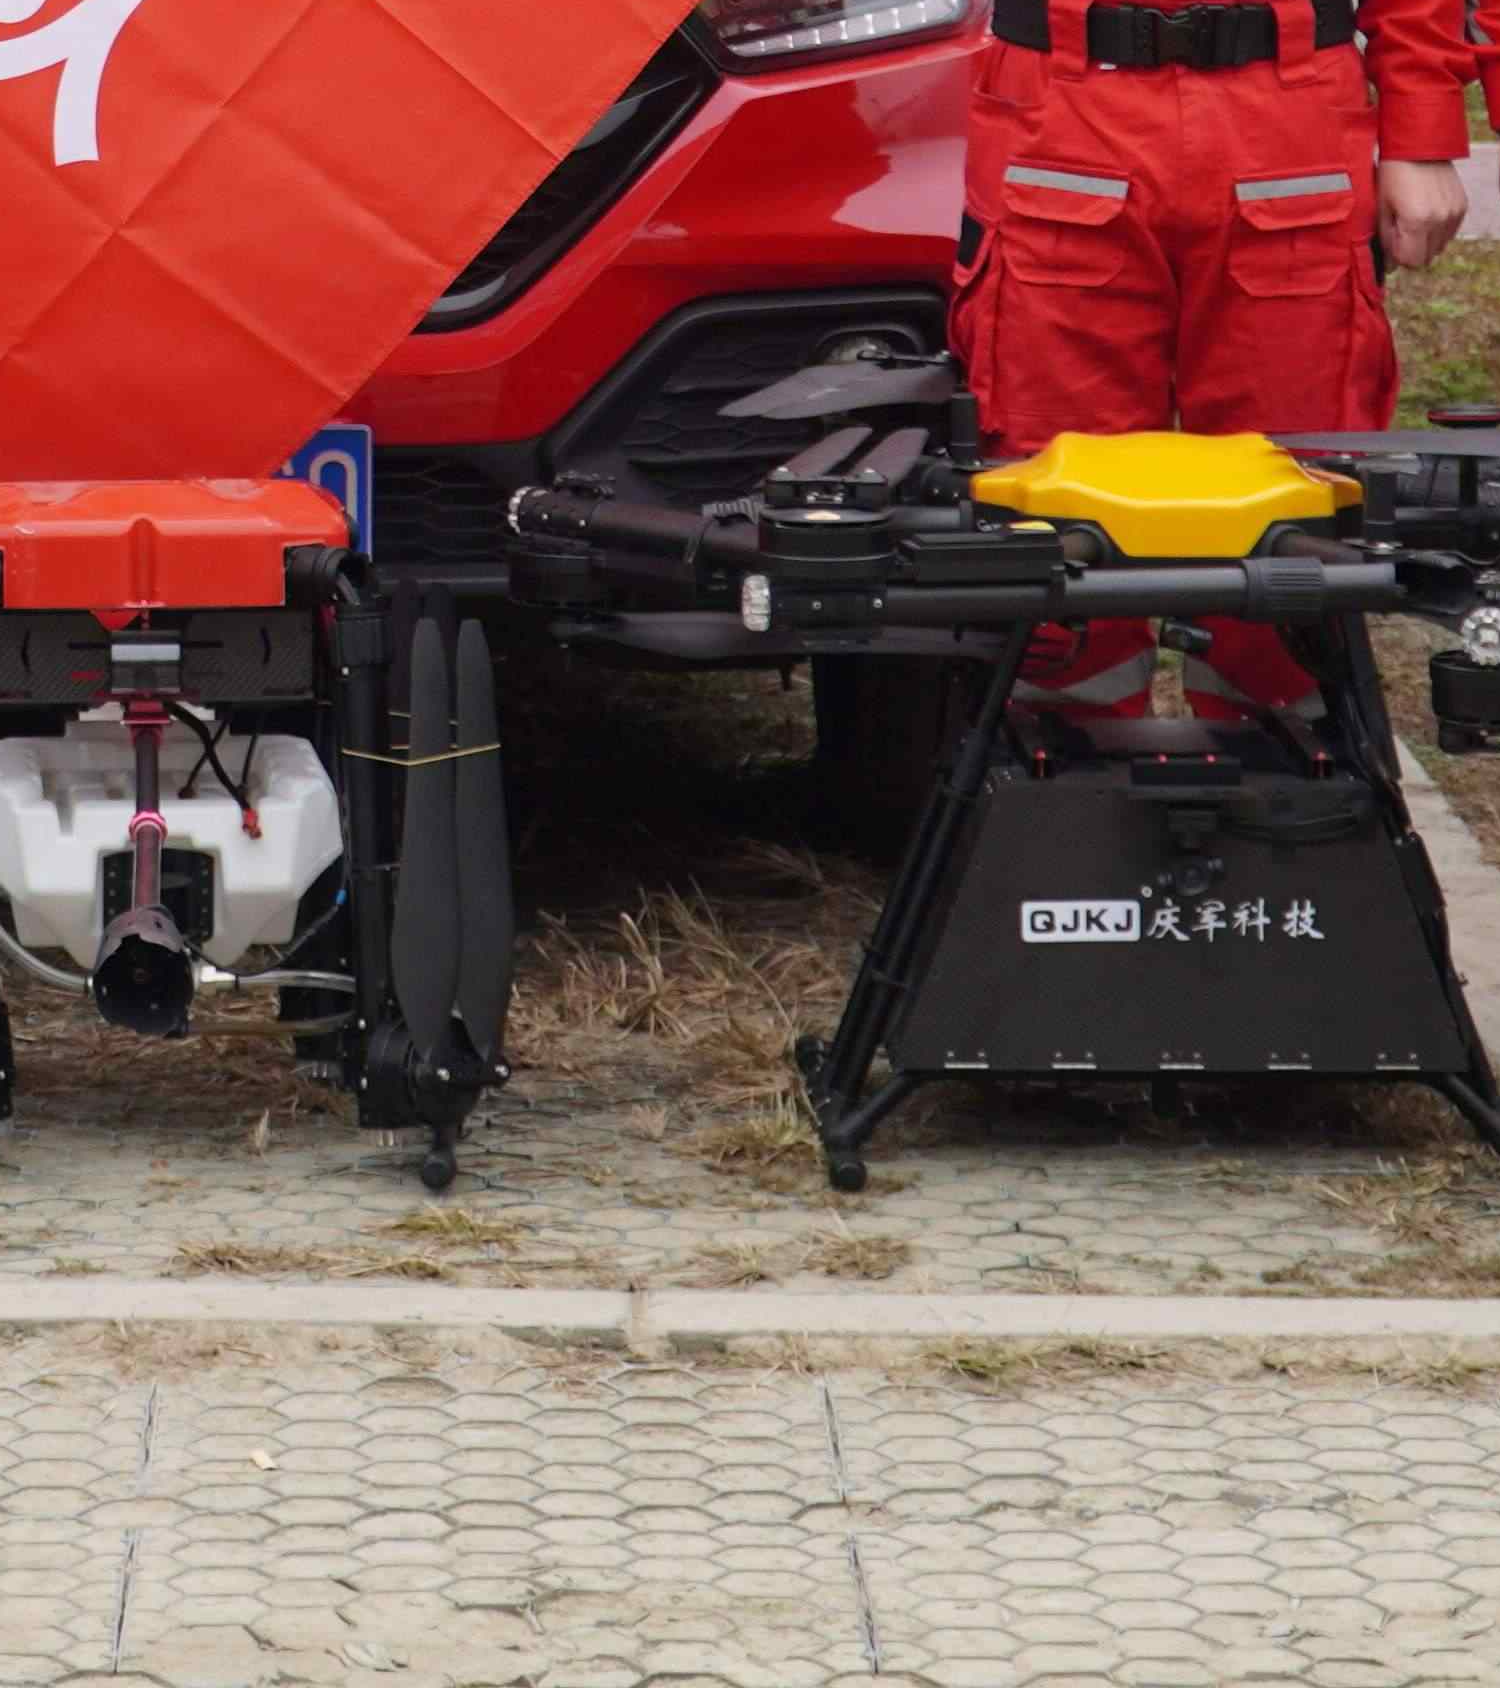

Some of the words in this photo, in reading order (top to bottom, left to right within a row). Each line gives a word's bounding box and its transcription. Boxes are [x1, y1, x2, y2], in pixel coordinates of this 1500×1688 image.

[1029, 908, 1134, 934] QJKJ
[1147, 897, 1326, 943] 庆军科技
